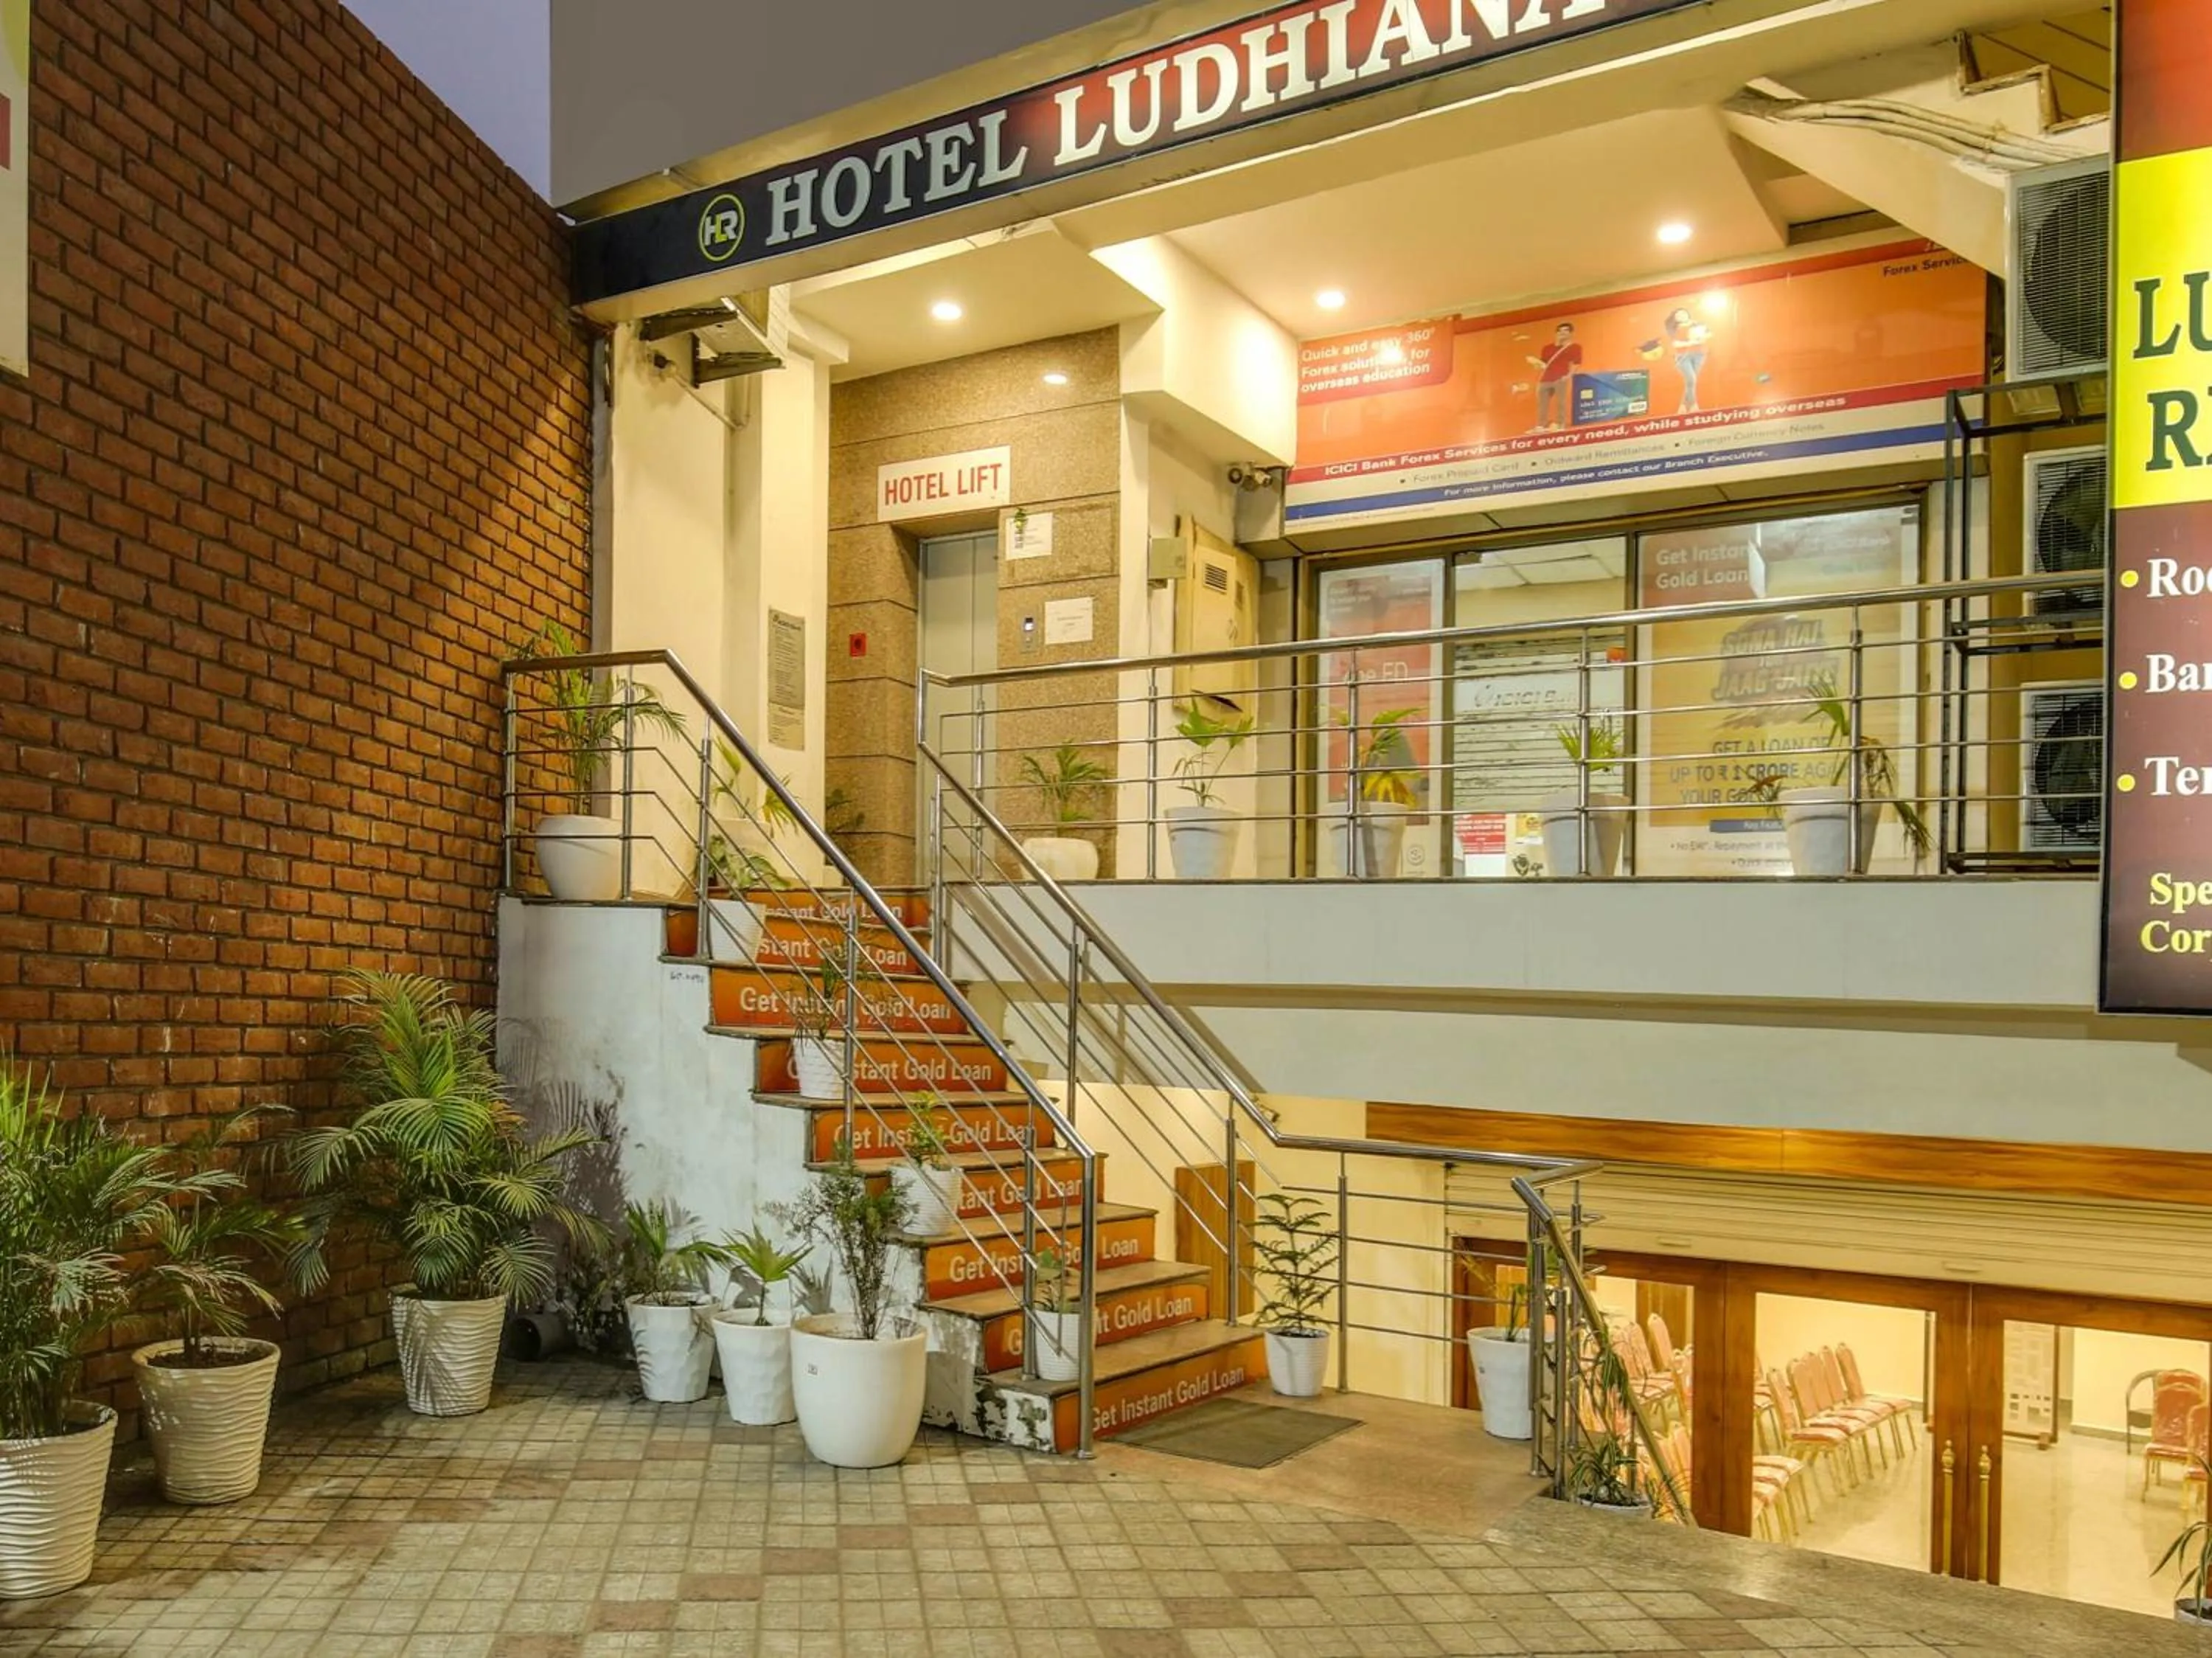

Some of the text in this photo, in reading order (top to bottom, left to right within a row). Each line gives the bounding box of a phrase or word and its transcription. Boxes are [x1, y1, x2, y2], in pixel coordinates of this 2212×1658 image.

[765, 109, 1029, 247] HOTEL
[1882, 257, 1969, 277] Forex Servic
[1301, 362, 1339, 379] Forex
[1411, 347, 1430, 360] for
[1302, 346, 1339, 363] Quick
[1343, 341, 1368, 355] and
[1301, 363, 1430, 392] overseas education
[1325, 397, 1846, 476] ICICI Bank Forex Services for every need, while studying overseas
[2146, 386, 2212, 471] R
[885, 463, 1002, 505] HOTEL LIFT
[1444, 488, 1460, 497] For
[1464, 485, 1490, 495] more
[1559, 471, 1595, 483] please
[1598, 465, 1641, 478] contact
[1642, 462, 1661, 473] our
[1665, 457, 1705, 471] Branch
[1655, 544, 1750, 566] Get Instan
[1655, 567, 1750, 589] Gold Loan
[2147, 558, 2212, 597] Ro
[1713, 740, 1742, 754] GET
[1747, 740, 1756, 753] A
[1670, 766, 1690, 784] UP
[1696, 765, 1715, 782] TO
[1746, 763, 1798, 780] CRORE
[760, 936, 812, 958] stant
[2141, 920, 2212, 961] Cor
[740, 987, 779, 1013] Get
[904, 1058, 947, 1081] Gold
[951, 1058, 992, 1081] Loan
[950, 1120, 992, 1145] Gold
[950, 1252, 986, 1283] Get
[1102, 1235, 1138, 1259] Loan
[1114, 1300, 1152, 1331] Gold
[1155, 1296, 1193, 1319] Loan
[1121, 1387, 1174, 1423] Instant
[1176, 1378, 1209, 1404] Gold
[1212, 1366, 1245, 1392] Loan
